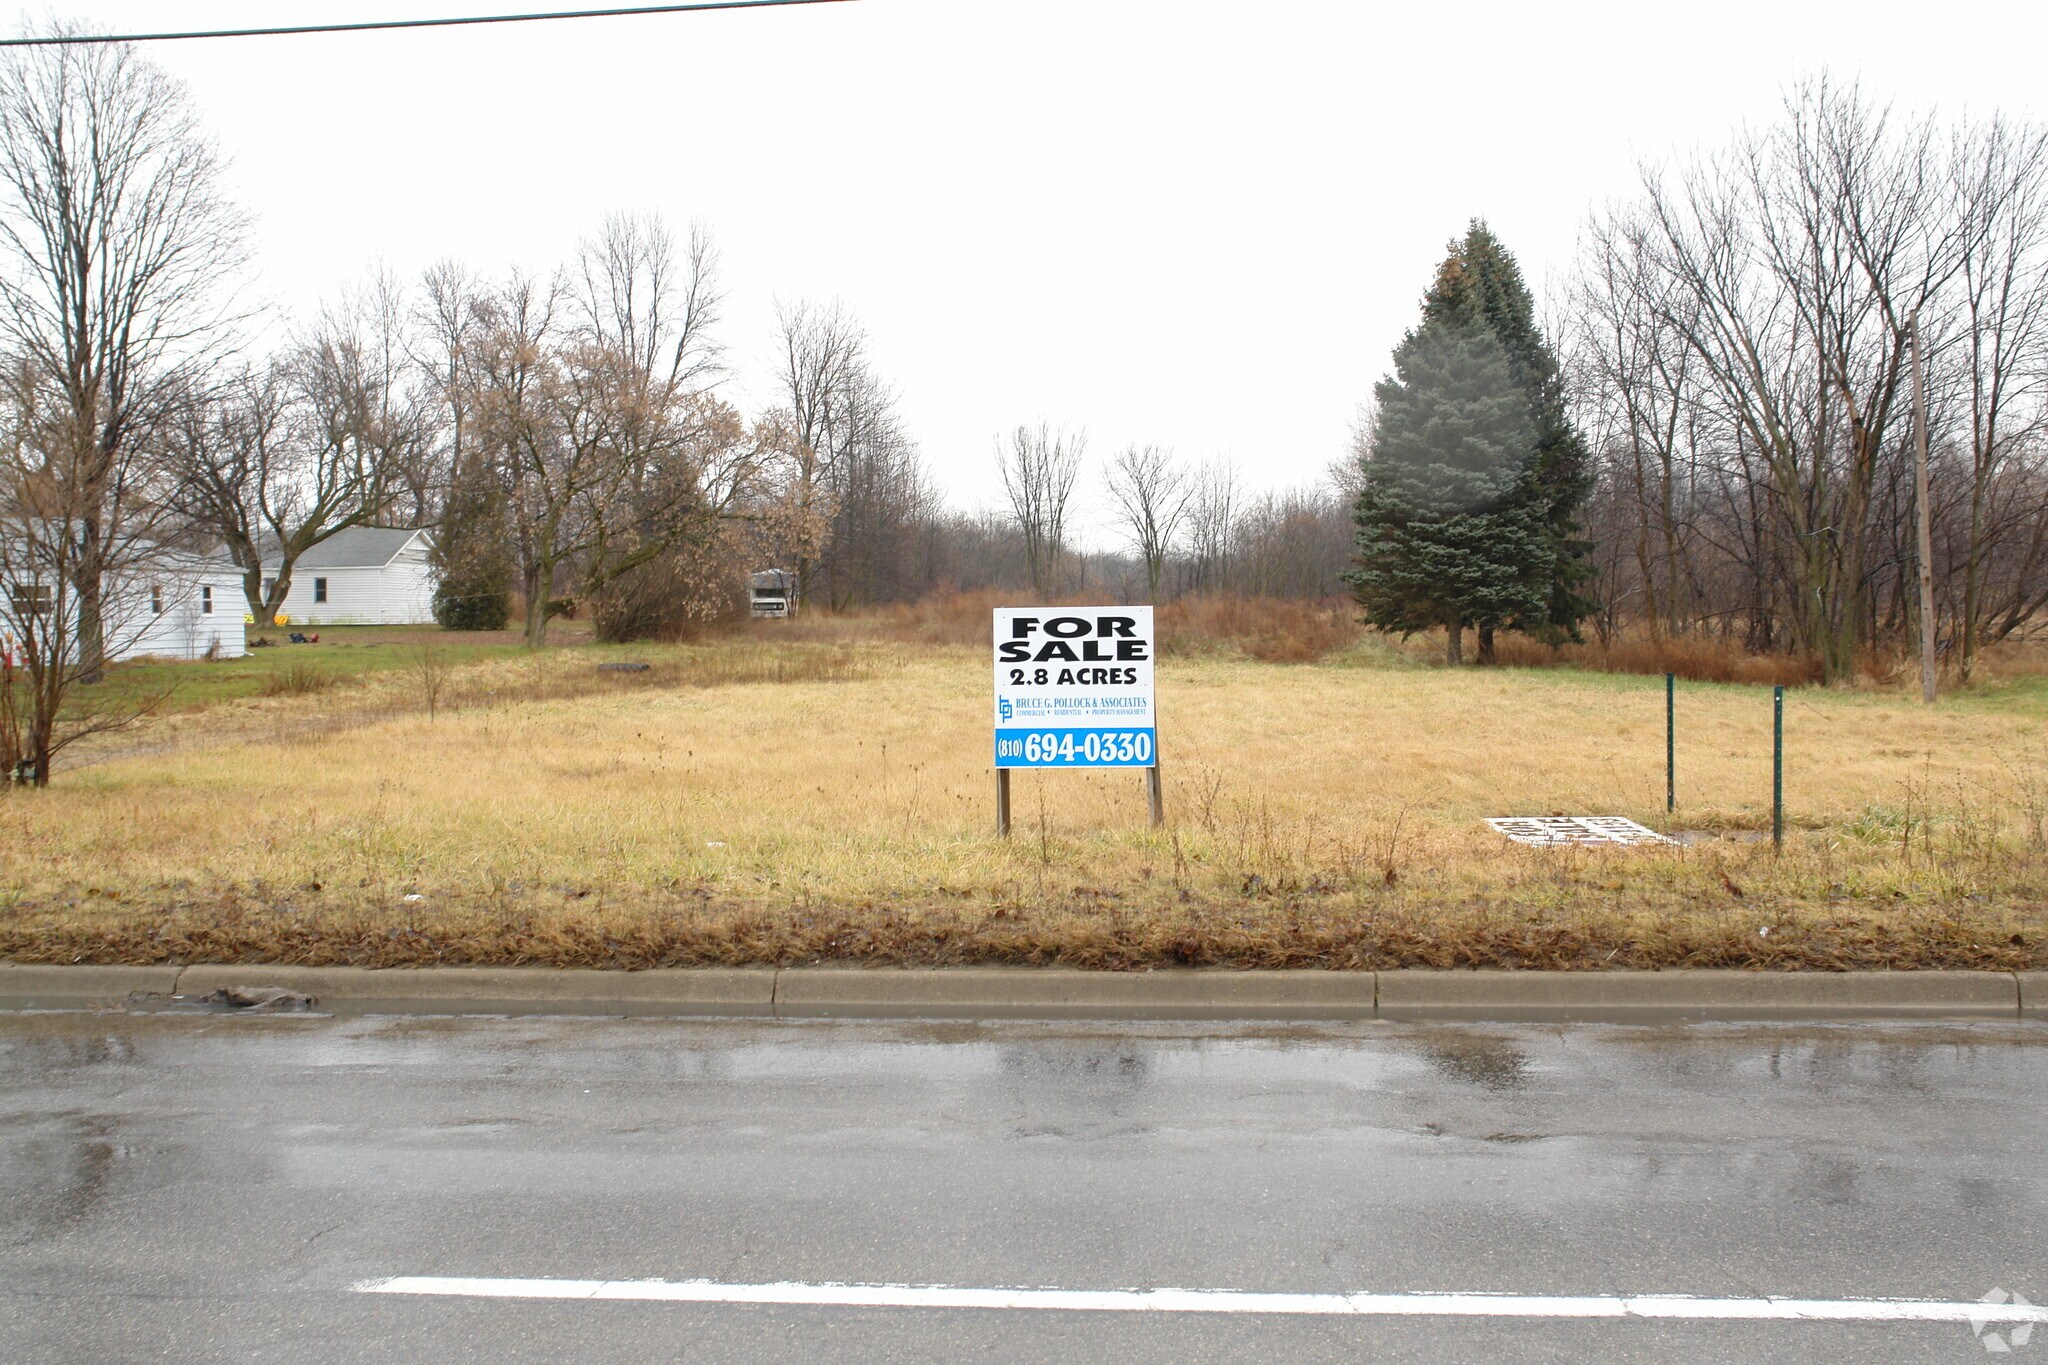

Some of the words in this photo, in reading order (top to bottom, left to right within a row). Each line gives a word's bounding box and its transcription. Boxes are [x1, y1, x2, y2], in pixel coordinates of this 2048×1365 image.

[1012, 616, 1137, 639] FOR
[998, 640, 1150, 663] SALE
[1009, 668, 1049, 686] 2.8
[1056, 667, 1138, 686] ACRES
[1016, 697, 1043, 709] BRUCE
[1044, 697, 1053, 709] G.
[1054, 697, 1091, 708] POLLOCK
[1092, 697, 1099, 708] &
[1099, 696, 1147, 708] ASSOCIATES
[998, 737, 1023, 759] (810)
[1024, 732, 1152, 762] 694-0330
